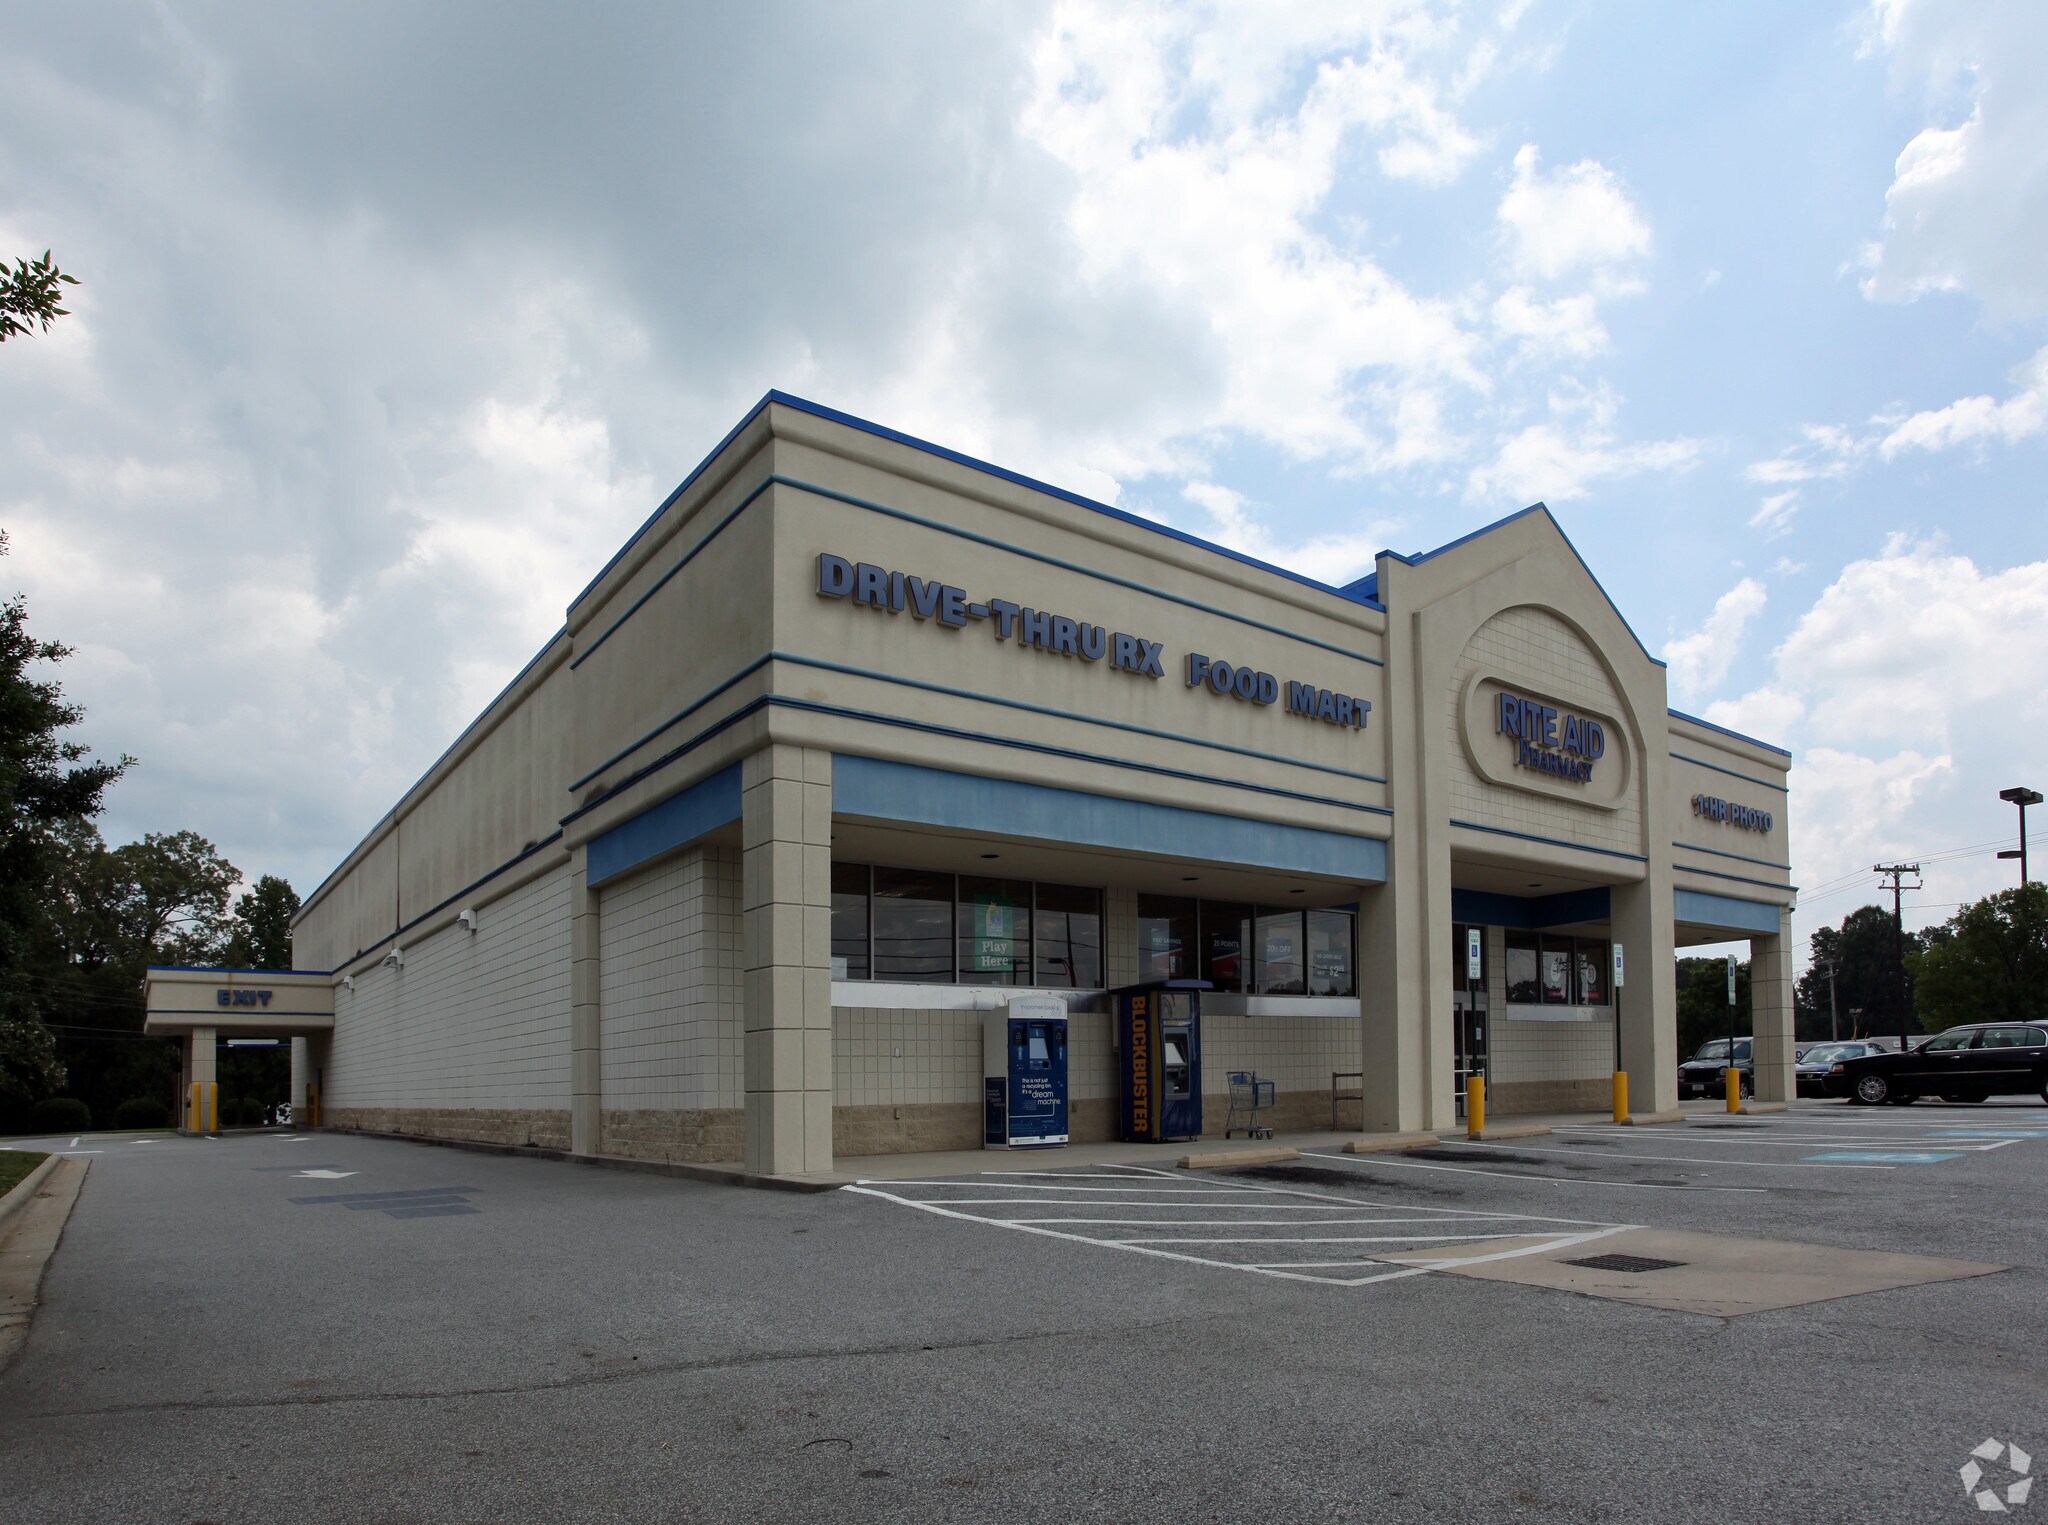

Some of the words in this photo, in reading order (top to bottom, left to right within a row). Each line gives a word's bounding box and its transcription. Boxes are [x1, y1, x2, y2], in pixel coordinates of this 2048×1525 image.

[817, 552, 1106, 662] DRIVE-THRU
[1110, 630, 1165, 679] RX
[1186, 651, 1279, 706] FOOD
[1285, 679, 1372, 730] MART
[1498, 692, 1559, 748] RITE
[1561, 714, 1605, 760] AID
[1517, 737, 1594, 783] PHARMACY
[1695, 793, 1727, 821] 1-HR
[1730, 802, 1773, 832] PHOTO
[982, 940, 1007, 955] Play
[1220, 939, 1240, 948] POINTS
[1279, 945, 1292, 953] OFF
[981, 955, 1009, 967] Here
[216, 989, 273, 1007] EXIT
[1132, 995, 1148, 1132] BLOCKBUSTER
[1032, 1090, 1054, 1098] dream
